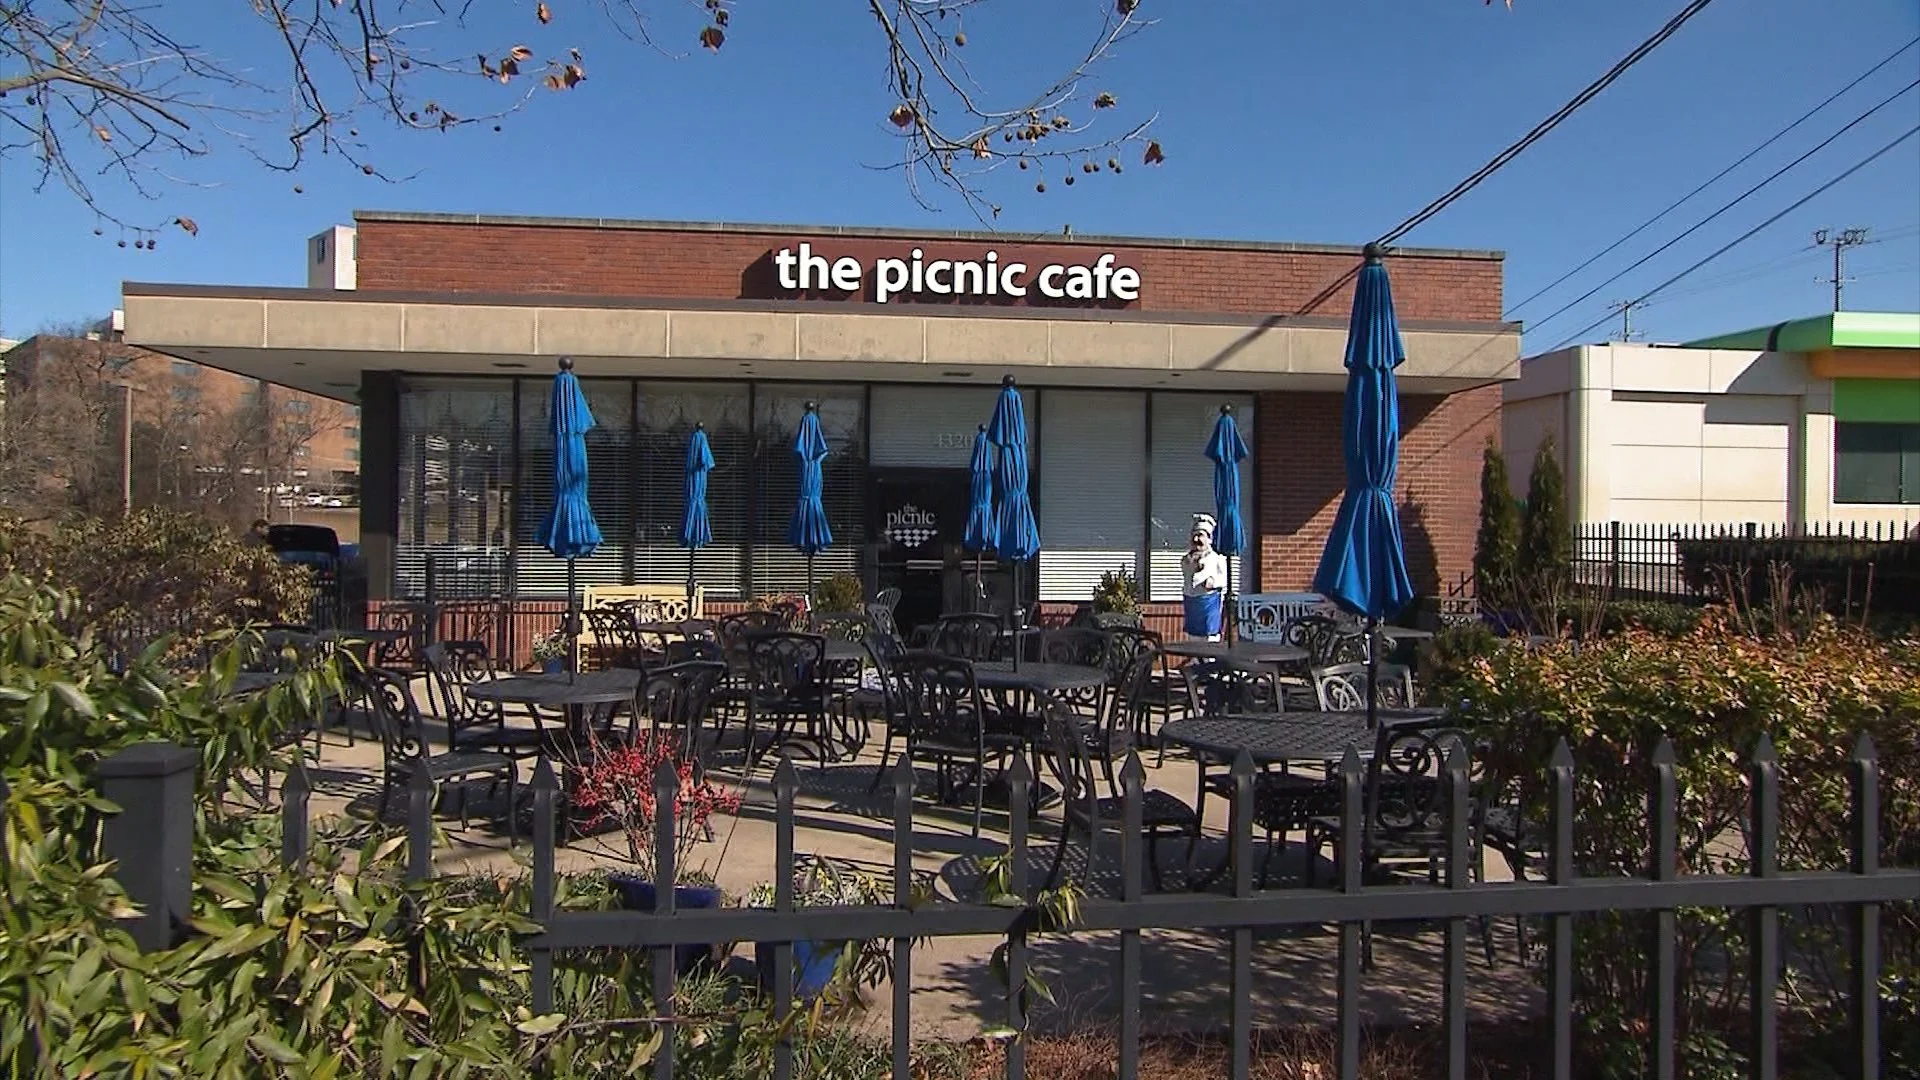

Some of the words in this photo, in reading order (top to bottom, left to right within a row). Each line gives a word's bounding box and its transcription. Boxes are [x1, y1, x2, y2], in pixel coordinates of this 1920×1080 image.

[775, 243, 862, 291] the
[876, 248, 1027, 303] picnic
[1037, 253, 1141, 300] cafe
[903, 503, 918, 513] the
[886, 509, 936, 529] picnic
